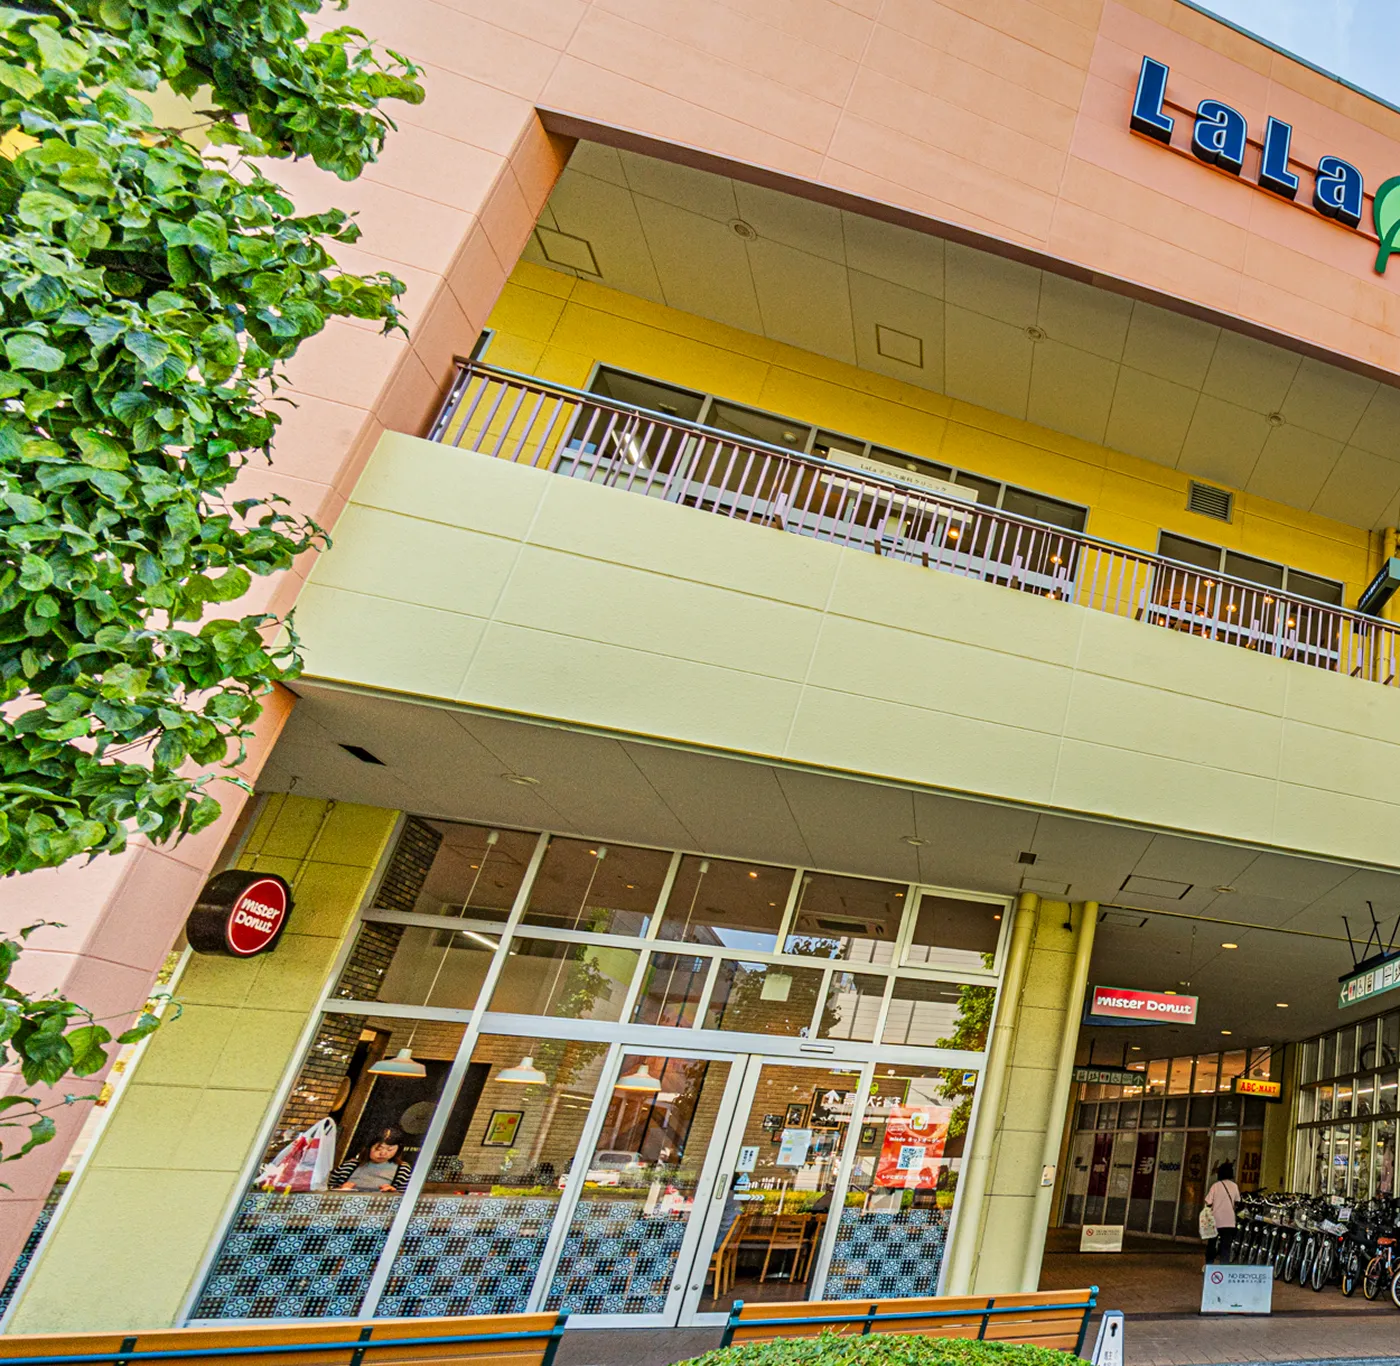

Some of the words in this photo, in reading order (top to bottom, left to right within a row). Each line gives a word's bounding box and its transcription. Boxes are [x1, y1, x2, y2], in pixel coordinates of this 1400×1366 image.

[1131, 55, 1364, 228] LaLa
[235, 910, 273, 933] Donut
[1146, 1000, 1192, 1014] Donut
[1241, 1082, 1276, 1093] ABC-MART
